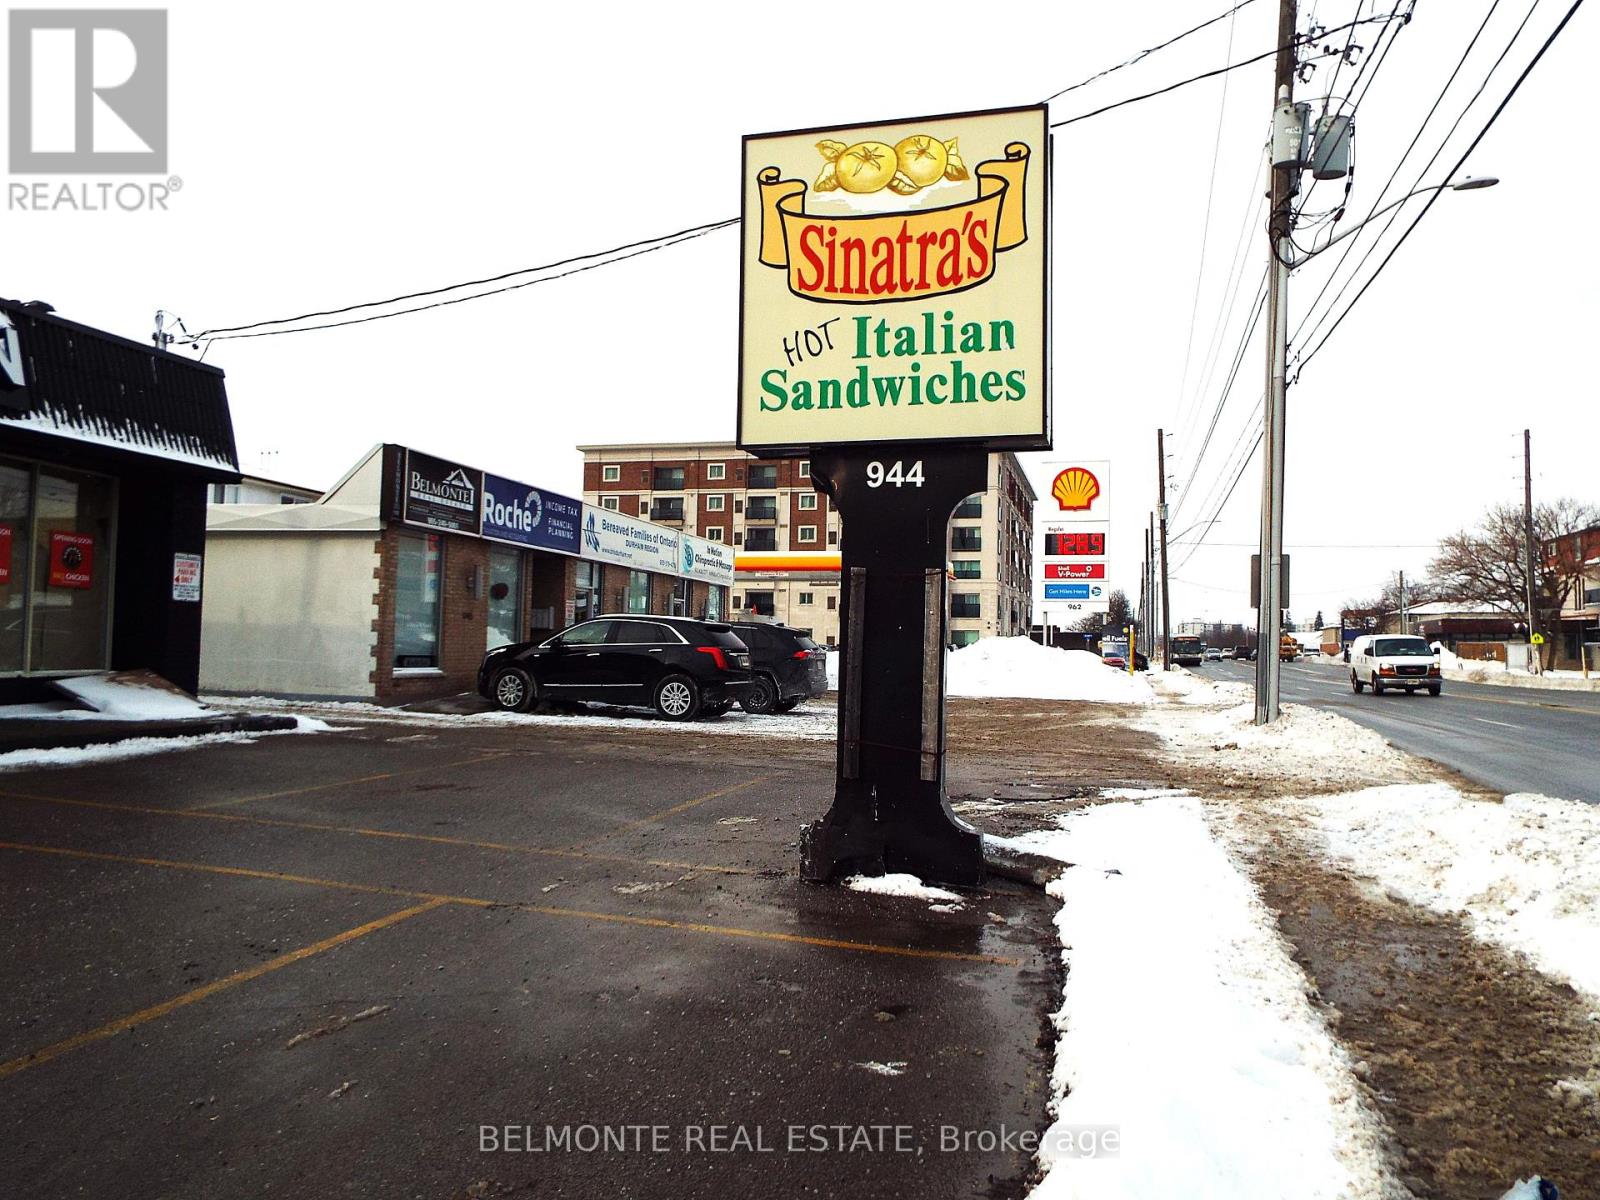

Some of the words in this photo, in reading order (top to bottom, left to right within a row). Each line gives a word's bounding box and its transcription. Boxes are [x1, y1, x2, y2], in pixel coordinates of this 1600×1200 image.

[798, 211, 989, 295] Sinatra's
[783, 317, 841, 367] HOT
[852, 310, 1015, 359] Italian
[760, 360, 1026, 412] Sandwiches
[411, 471, 470, 503] BELMONTE
[866, 460, 925, 488] 944
[545, 501, 566, 514] INCOME
[567, 506, 578, 517] TAX
[548, 517, 574, 531] FINANCIAL
[547, 527, 574, 540] PLANNING
[602, 519, 629, 537] Bereaved
[630, 527, 653, 543] Families
[653, 533, 659, 544] of
[660, 535, 678, 549] Ontario
[625, 539, 644, 551] DURHAM
